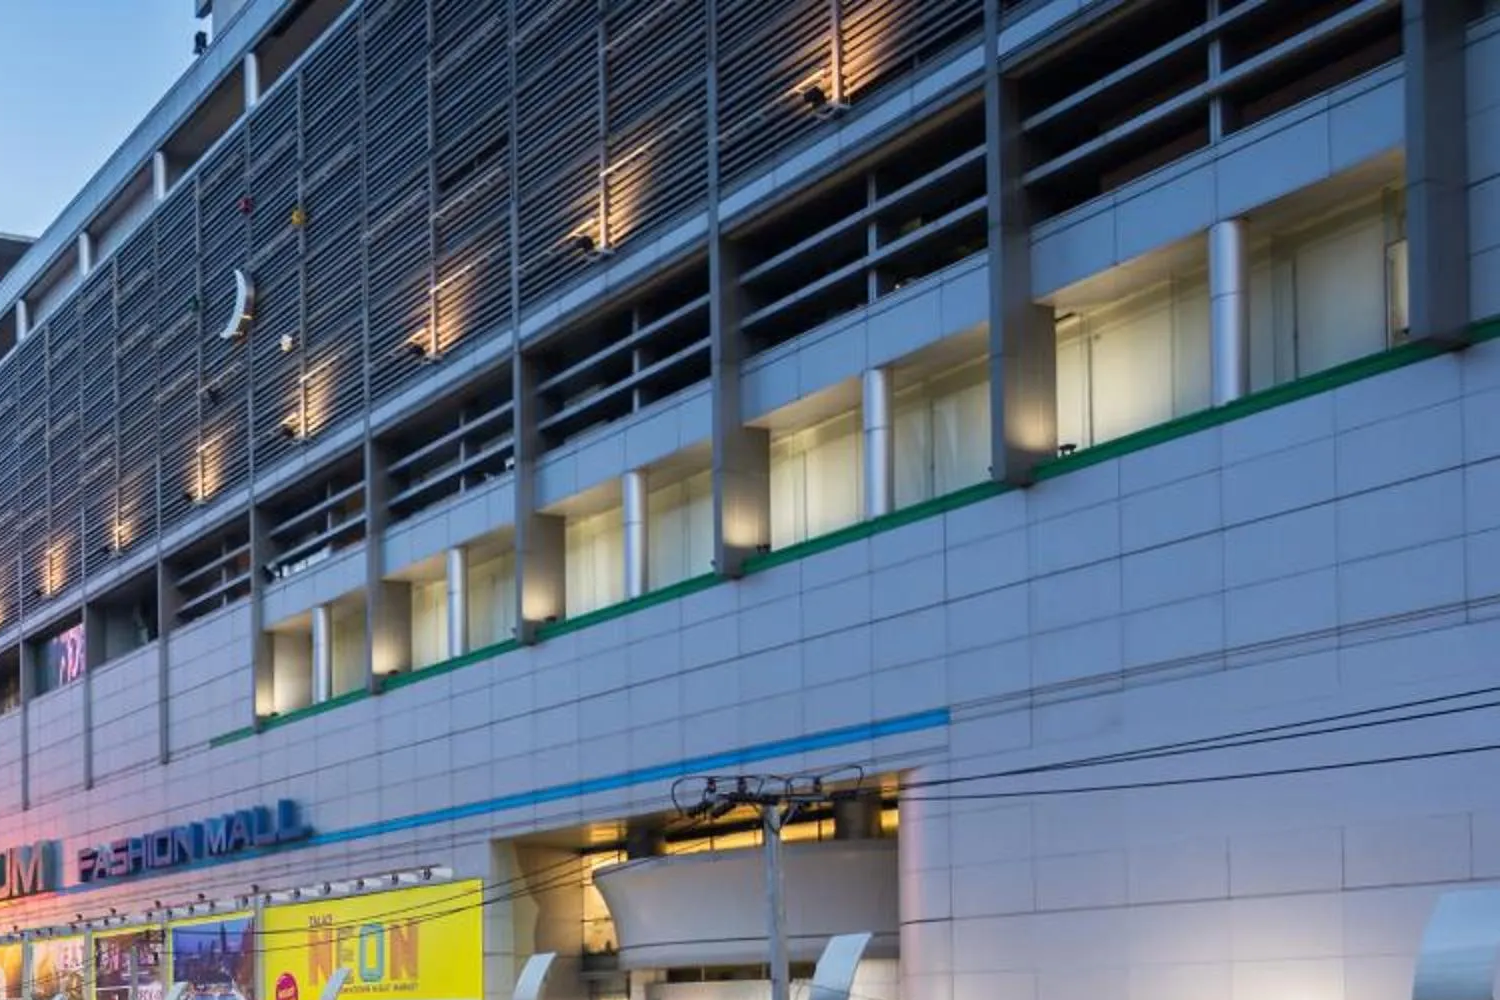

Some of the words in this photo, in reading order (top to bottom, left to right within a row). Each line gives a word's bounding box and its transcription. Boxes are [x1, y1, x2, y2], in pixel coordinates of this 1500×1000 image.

[77, 824, 202, 883] FASHION
[203, 800, 306, 857] MALL
[308, 919, 420, 985] NEON
